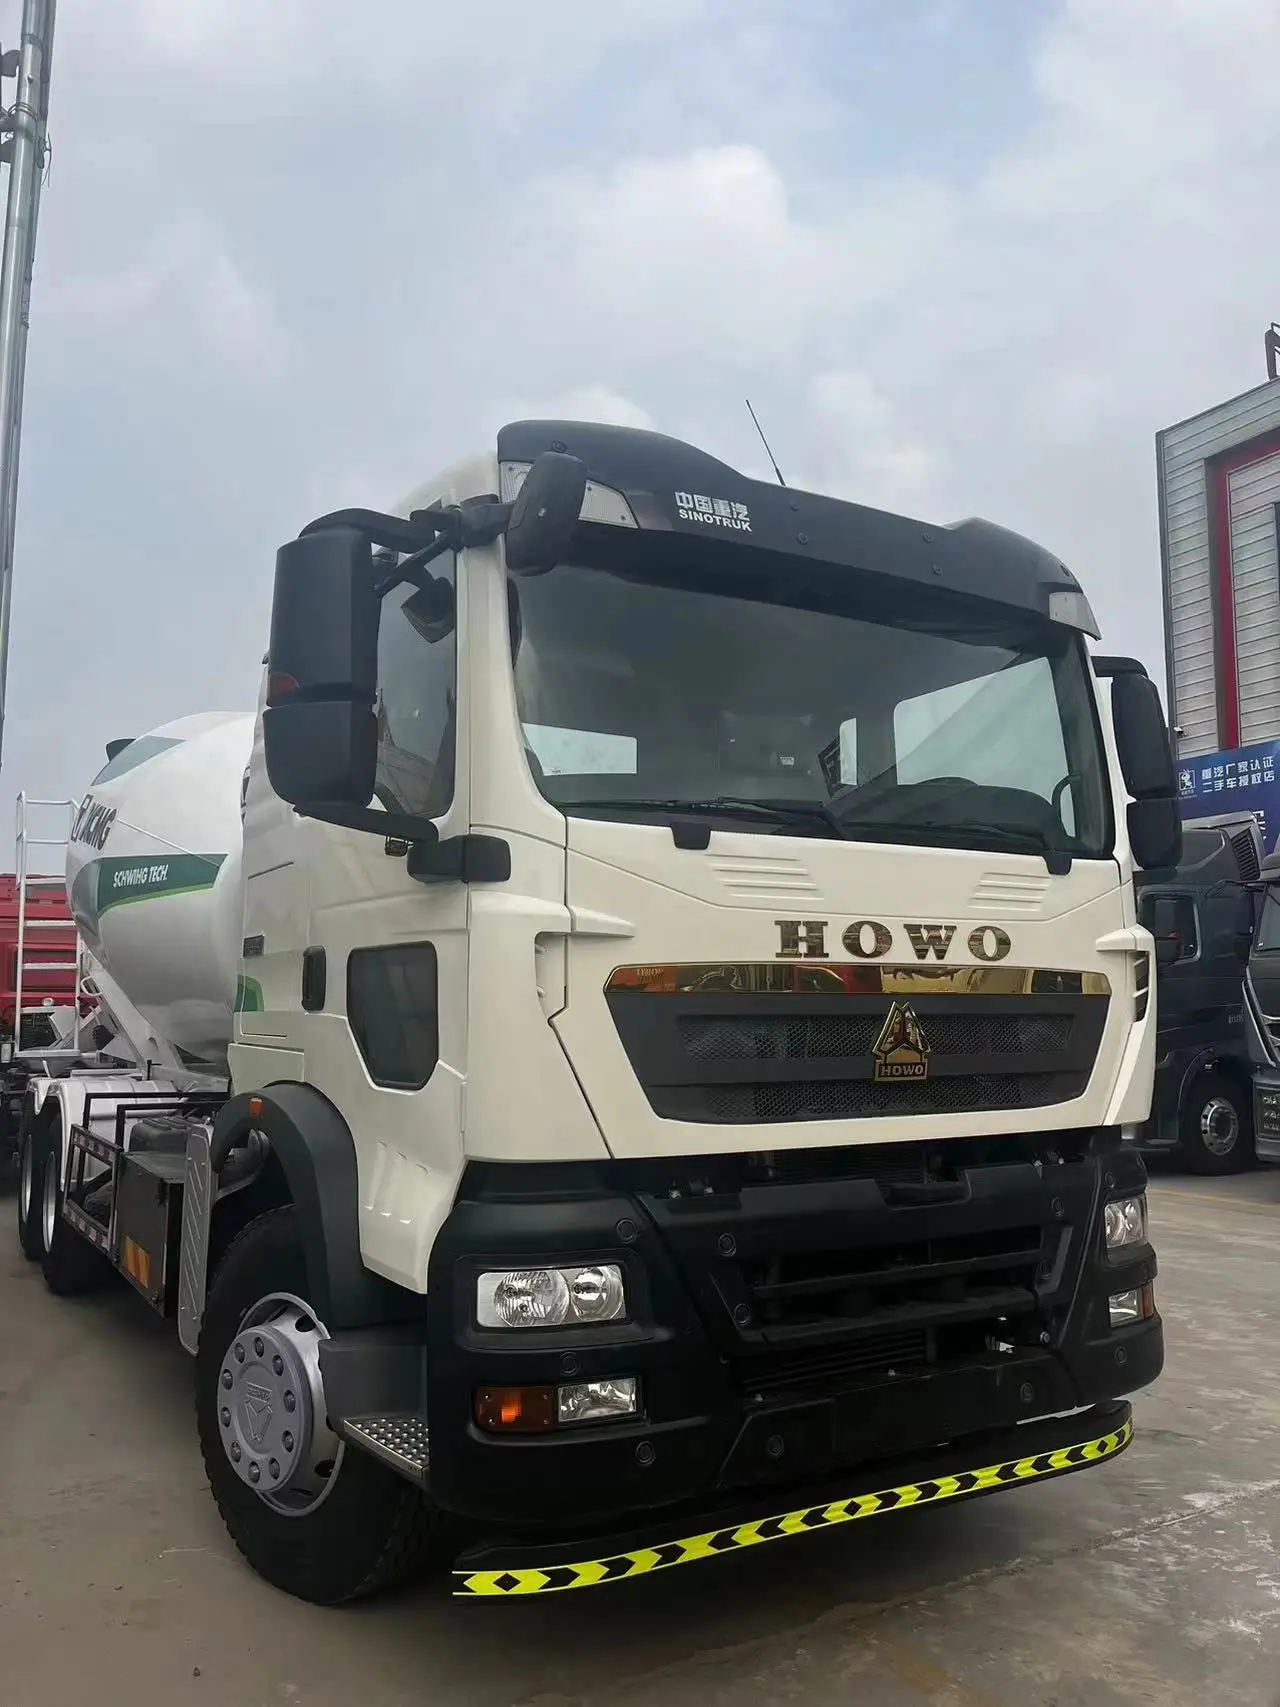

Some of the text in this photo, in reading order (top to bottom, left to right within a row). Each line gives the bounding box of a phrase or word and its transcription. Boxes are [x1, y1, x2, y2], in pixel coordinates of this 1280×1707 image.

[675, 491, 750, 521] 中国重汽
[678, 509, 752, 532] SINOTRUK
[1201, 756, 1274, 780] 重汽厂家认证
[1202, 770, 1275, 793] 二手车授权店
[774, 920, 1011, 962] HOWO
[880, 1064, 924, 1077] HOWO
